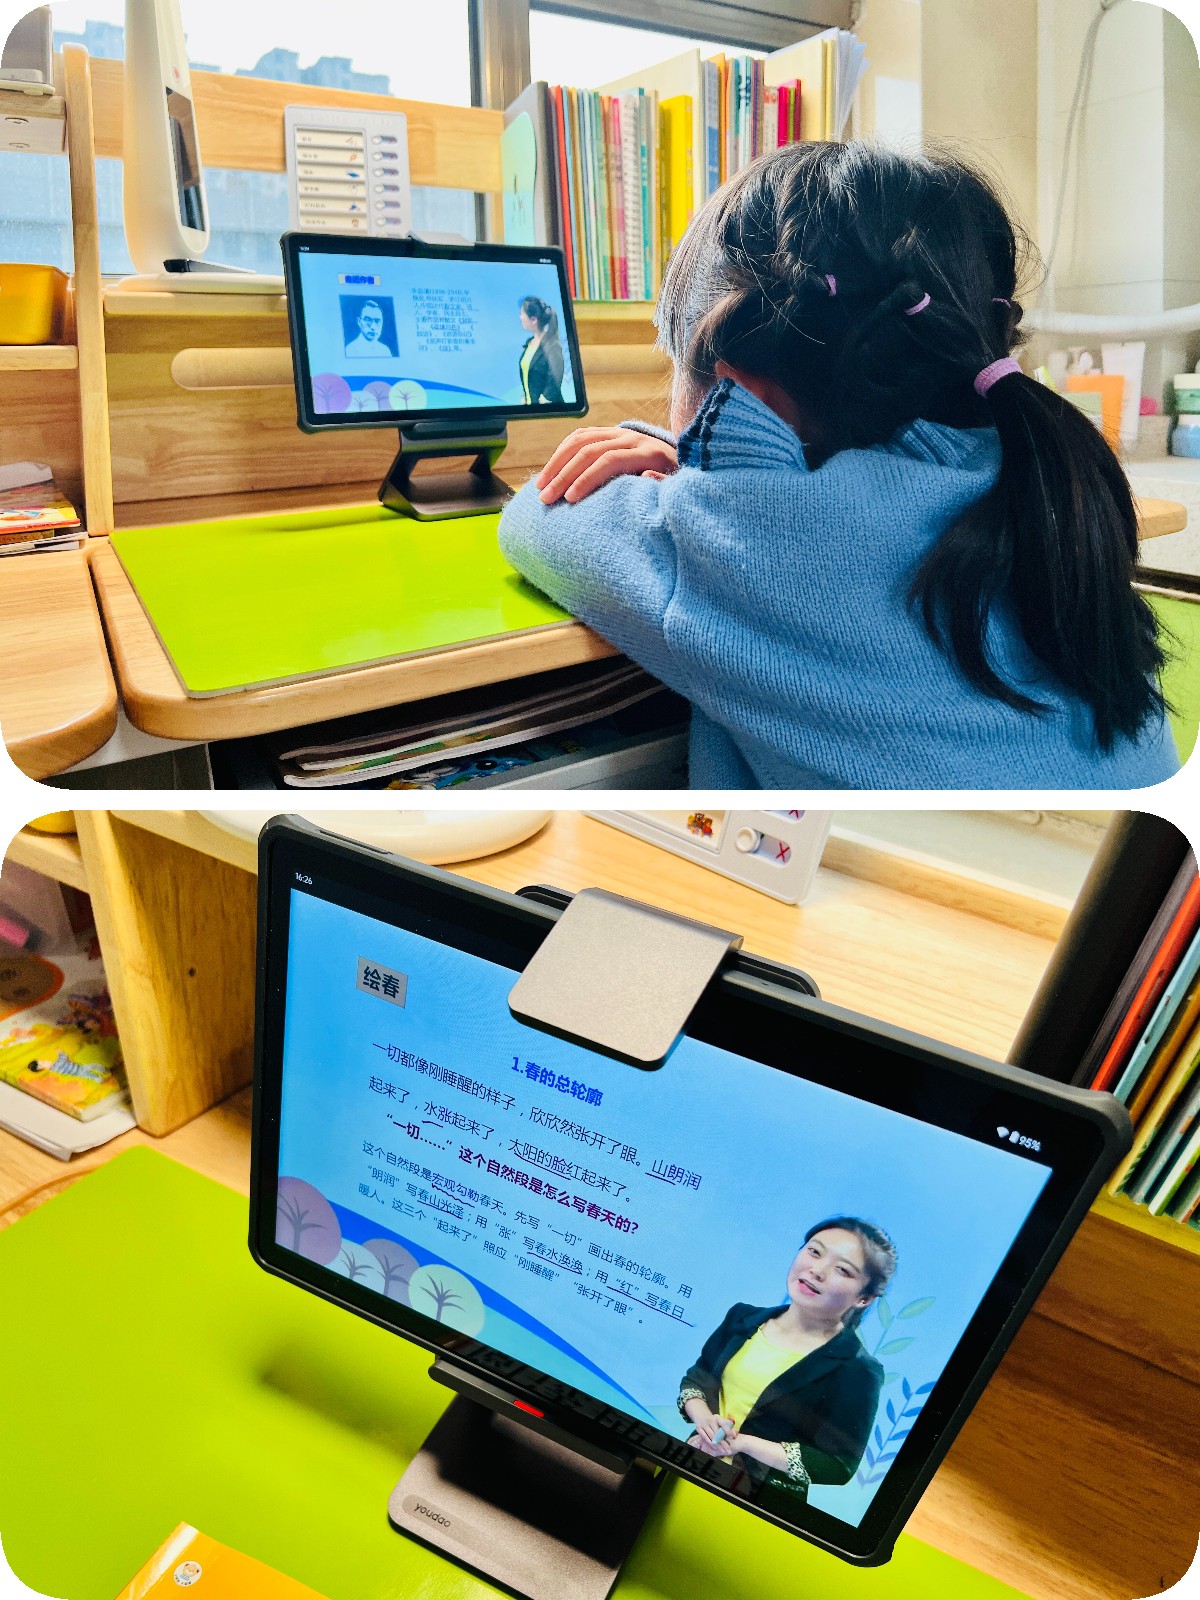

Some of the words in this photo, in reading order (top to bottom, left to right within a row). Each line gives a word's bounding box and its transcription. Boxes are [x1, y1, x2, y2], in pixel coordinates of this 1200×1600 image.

[295, 872, 313, 885] 16:26
[363, 966, 400, 999] 绘春
[511, 1056, 603, 1107] 1.春的总轮廓
[1019, 1135, 1041, 1152] 95%
[413, 1502, 452, 1527] youdao
